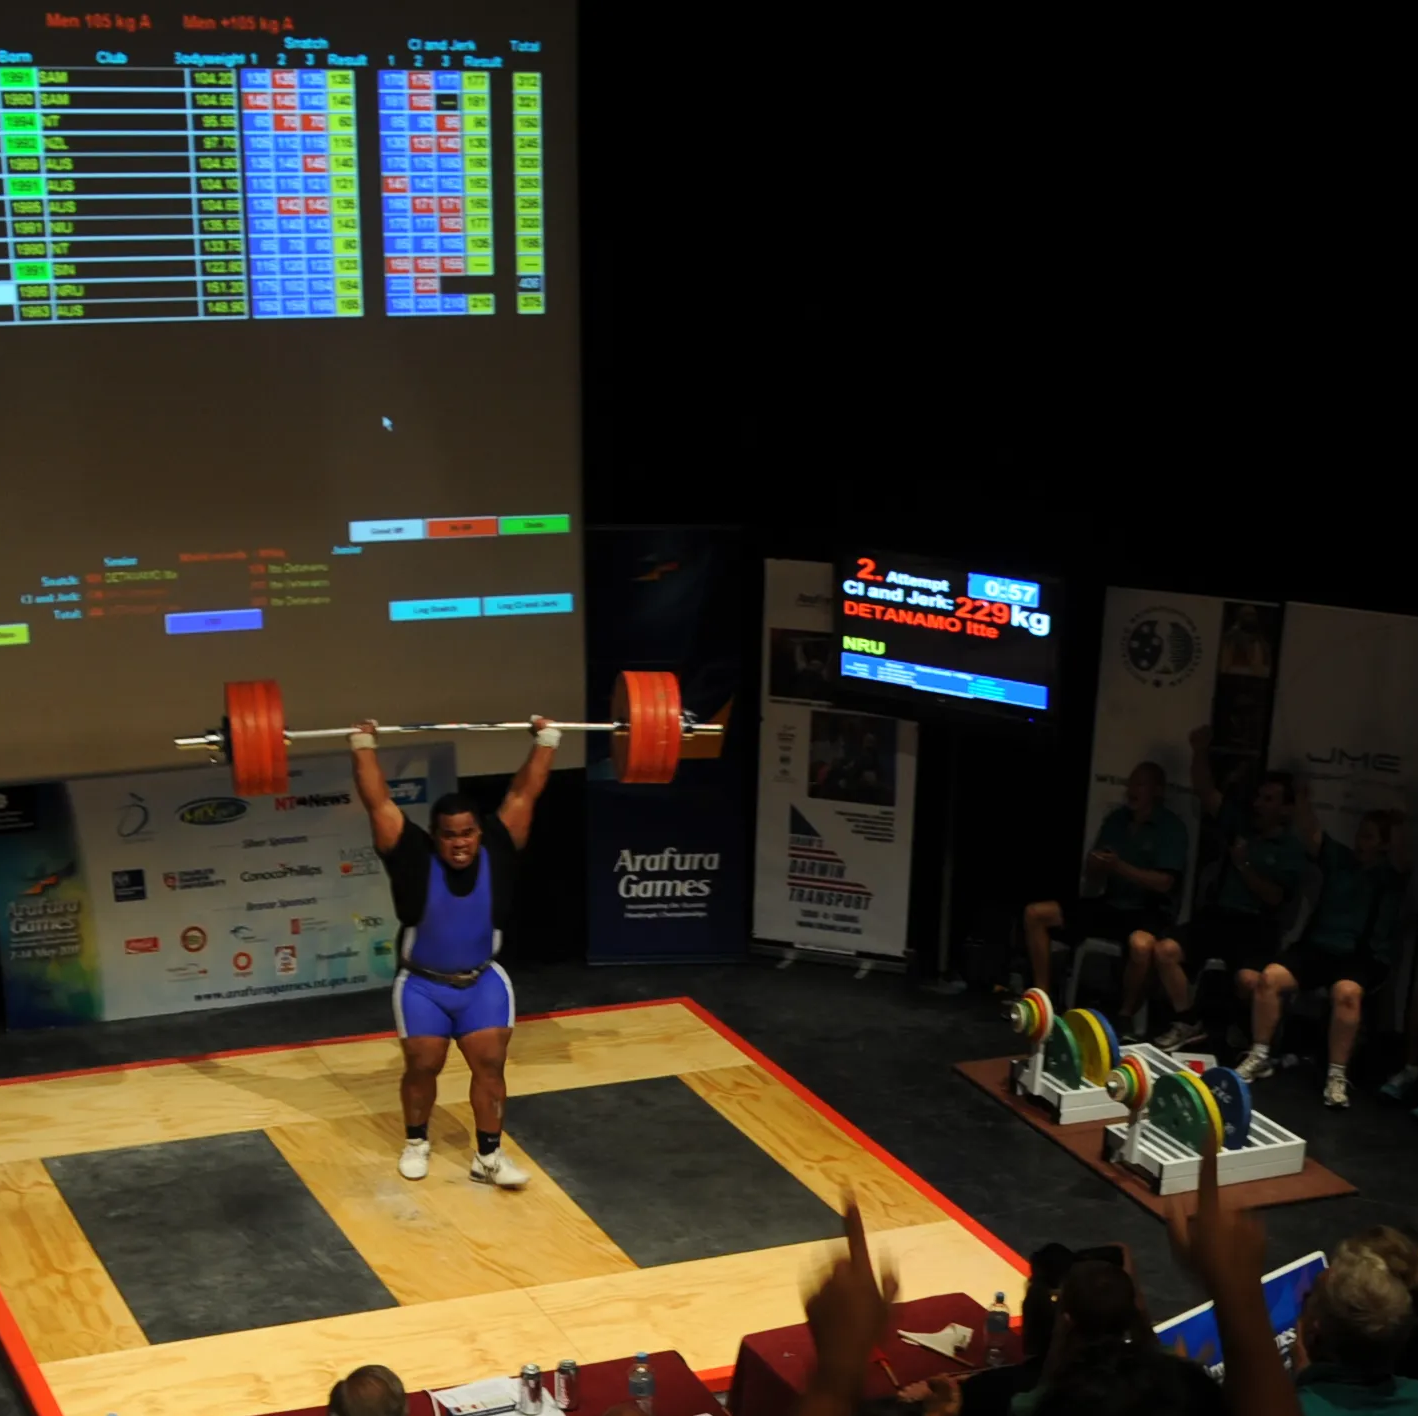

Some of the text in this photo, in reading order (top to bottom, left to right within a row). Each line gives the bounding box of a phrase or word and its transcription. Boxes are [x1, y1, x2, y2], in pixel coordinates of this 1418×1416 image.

[46, 13, 152, 31] Men 105 kg A
[183, 15, 216, 29] Men
[260, 17, 279, 34] kg
[283, 16, 294, 30] A
[510, 40, 541, 52] Total
[95, 51, 128, 64] Club
[250, 53, 258, 65] 1
[277, 53, 287, 65] 2
[305, 53, 315, 65] 3
[328, 53, 369, 66] Result
[388, 55, 396, 67] 1
[413, 55, 423, 67] 2
[441, 55, 451, 67] 3
[463, 55, 503, 68] Result
[856, 557, 951, 593] 2. Attempt
[867, 586, 905, 605] and
[906, 589, 955, 612] Jerk:
[984, 578, 1035, 603] 0:57
[843, 599, 1000, 640] DETANAMO Itte
[842, 635, 887, 656] NRU
[307, 792, 351, 810] News
[612, 846, 721, 873] Arafura
[788, 859, 847, 879] DARWIN
[239, 862, 324, 884] ConocoPhillips
[617, 874, 712, 899] Games
[788, 886, 873, 911] TRANSPORT
[5, 900, 80, 919] Arafura
[9, 916, 77, 935] Games
